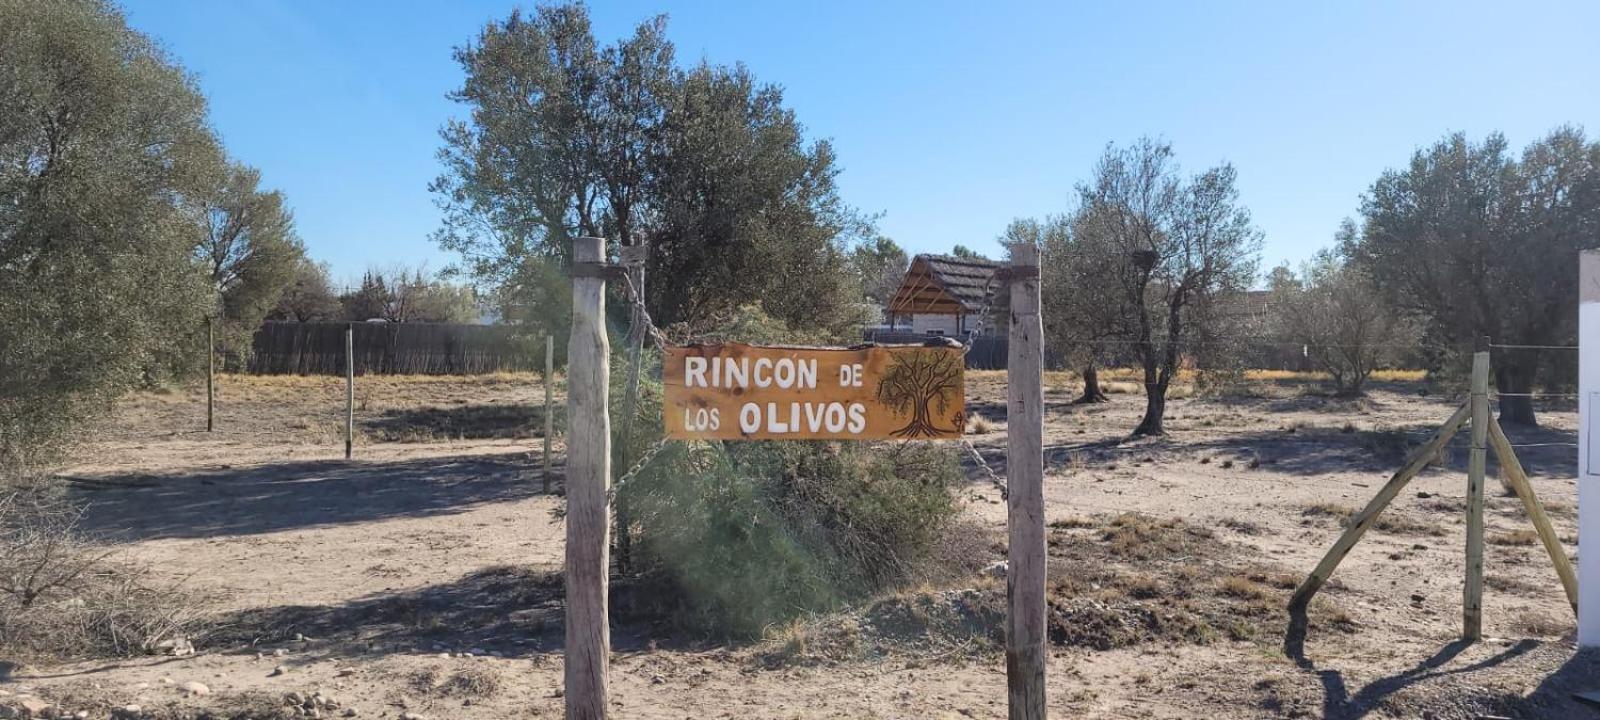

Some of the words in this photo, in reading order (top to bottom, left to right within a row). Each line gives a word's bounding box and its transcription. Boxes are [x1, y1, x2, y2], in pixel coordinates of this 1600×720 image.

[839, 364, 863, 387] DE
[684, 407, 720, 431] LOS
[740, 402, 866, 434] OLIVOS
